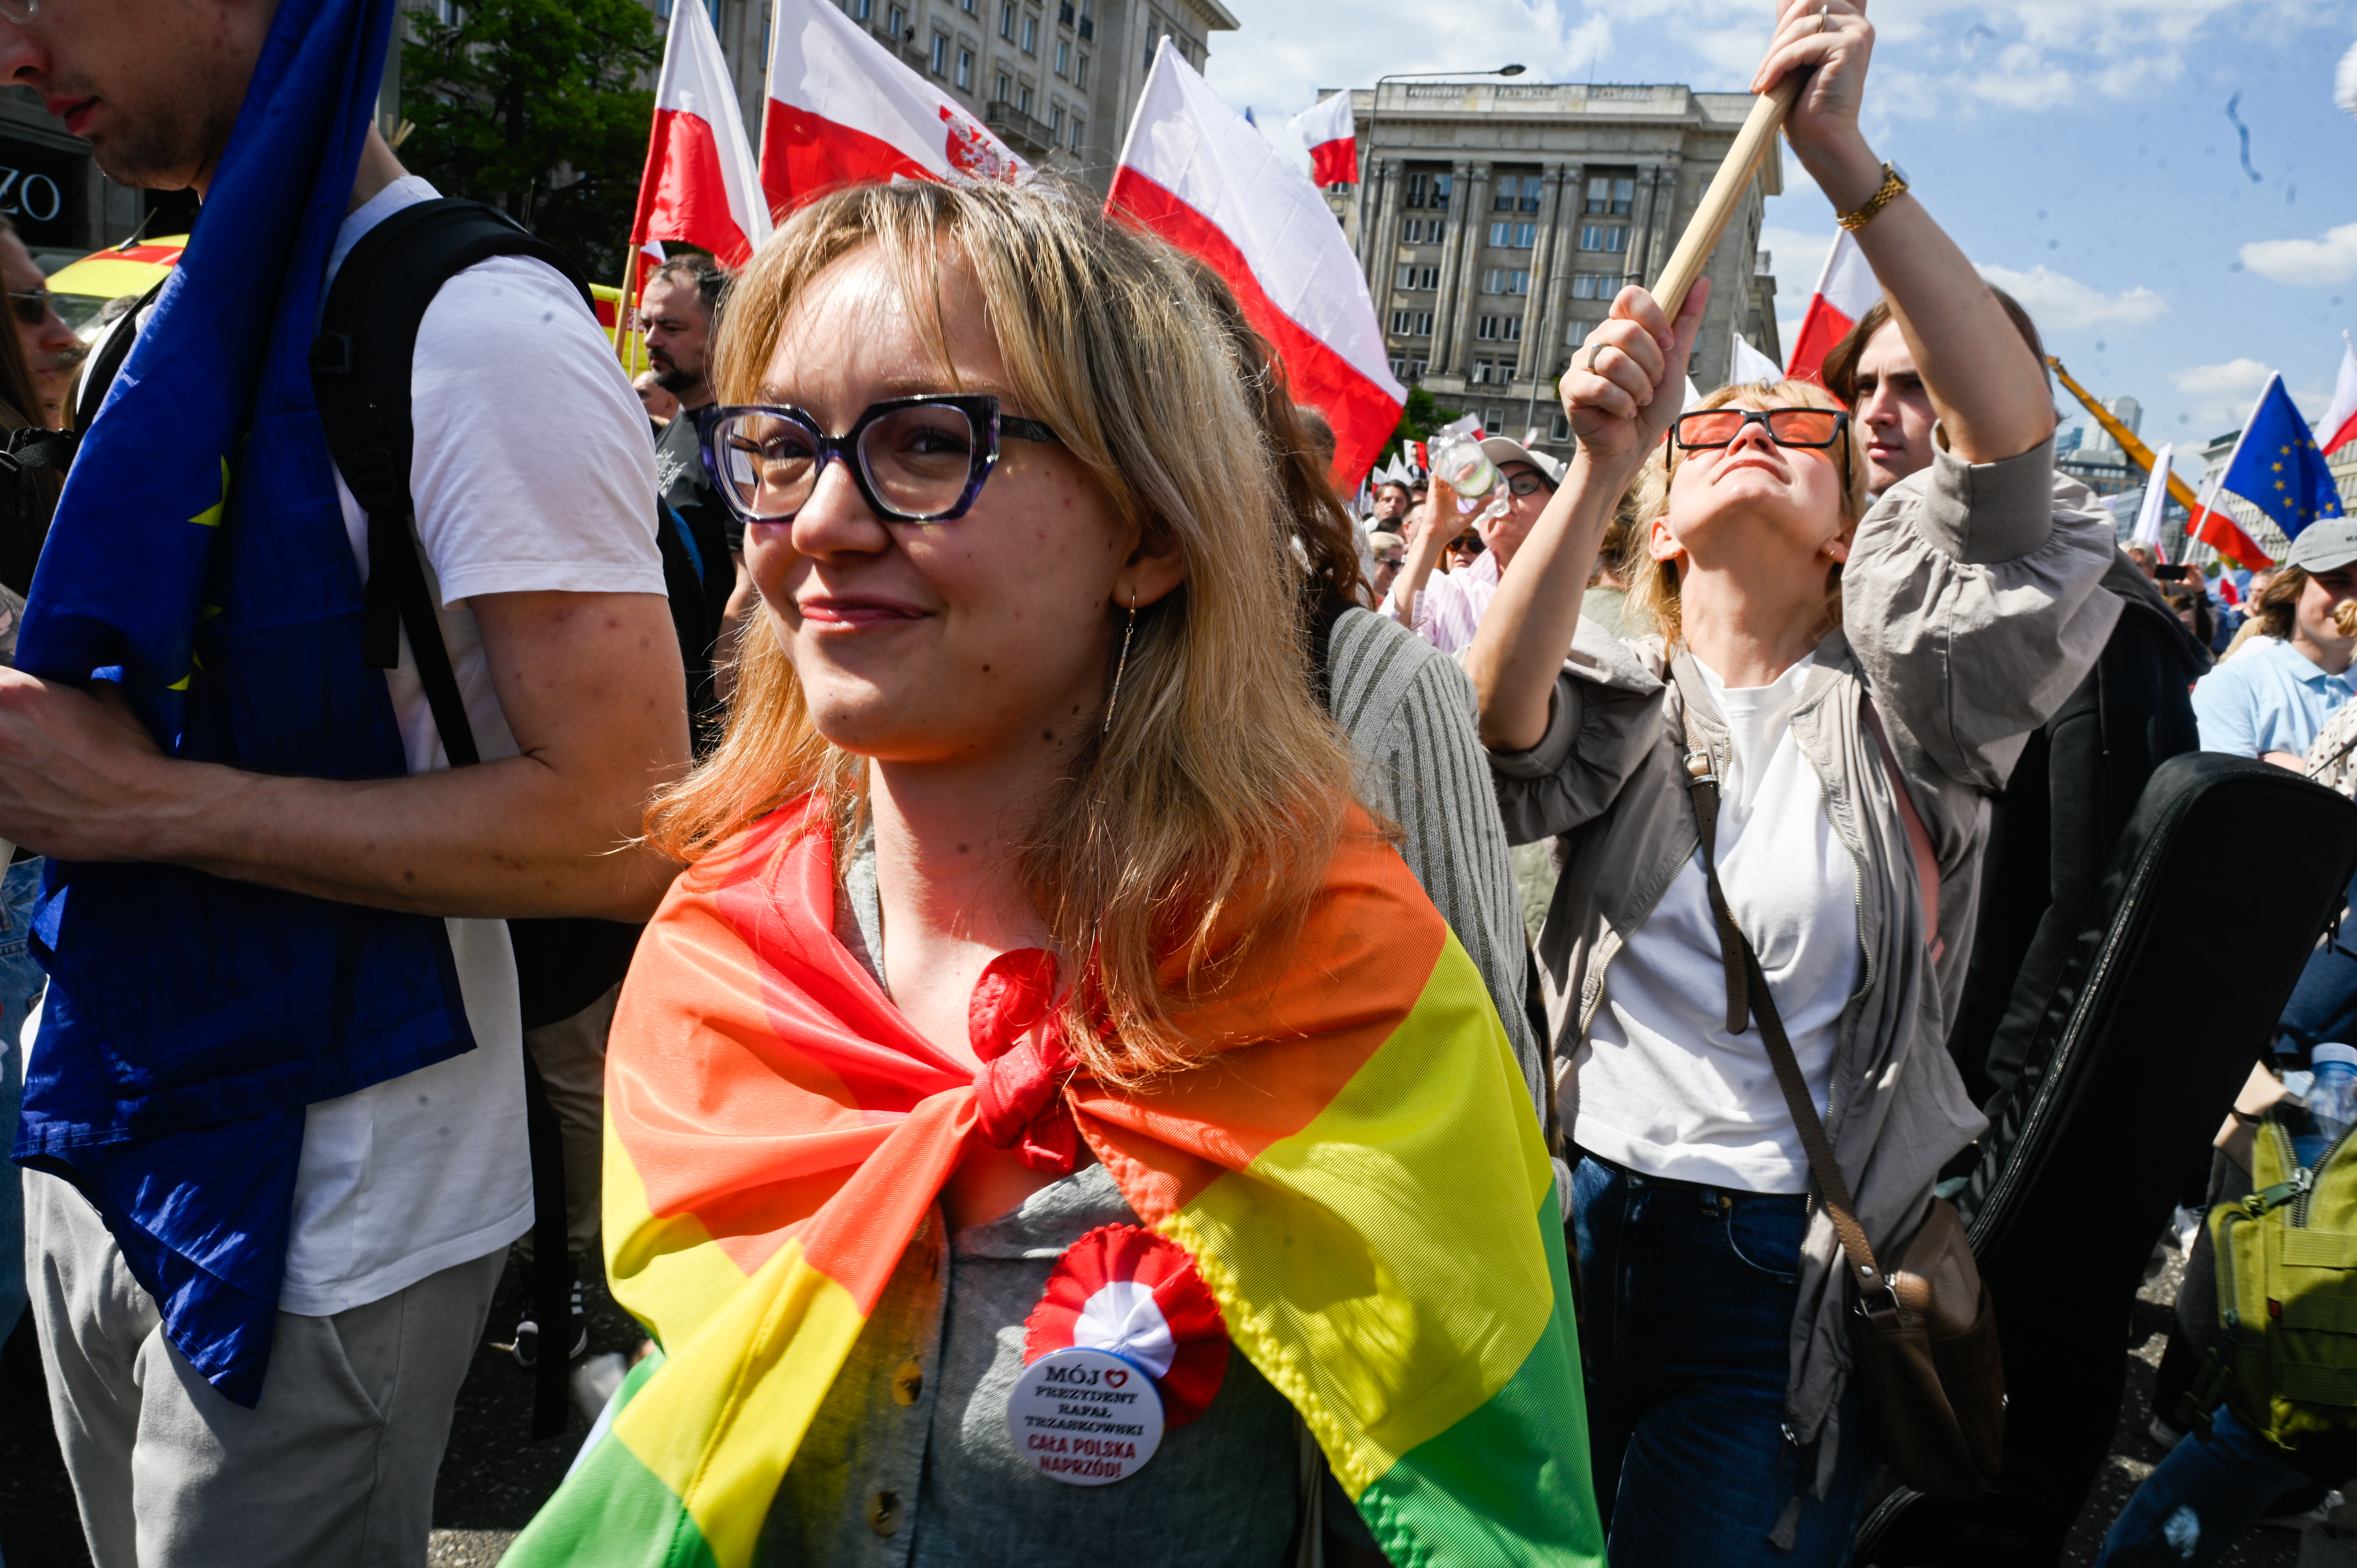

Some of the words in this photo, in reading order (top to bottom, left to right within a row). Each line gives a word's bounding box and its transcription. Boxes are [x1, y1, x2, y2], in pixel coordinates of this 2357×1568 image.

[1045, 1364, 1101, 1384] MÓJ
[1035, 1386, 1138, 1404] PREZYDENT
[1058, 1404, 1112, 1417] RAFAŁ
[1025, 1415, 1145, 1436] TRZASKOWSKI
[1028, 1434, 1068, 1453] CAŁA
[1073, 1438, 1136, 1459] POLSKA
[1041, 1456, 1122, 1478] NAPRZÓD!
